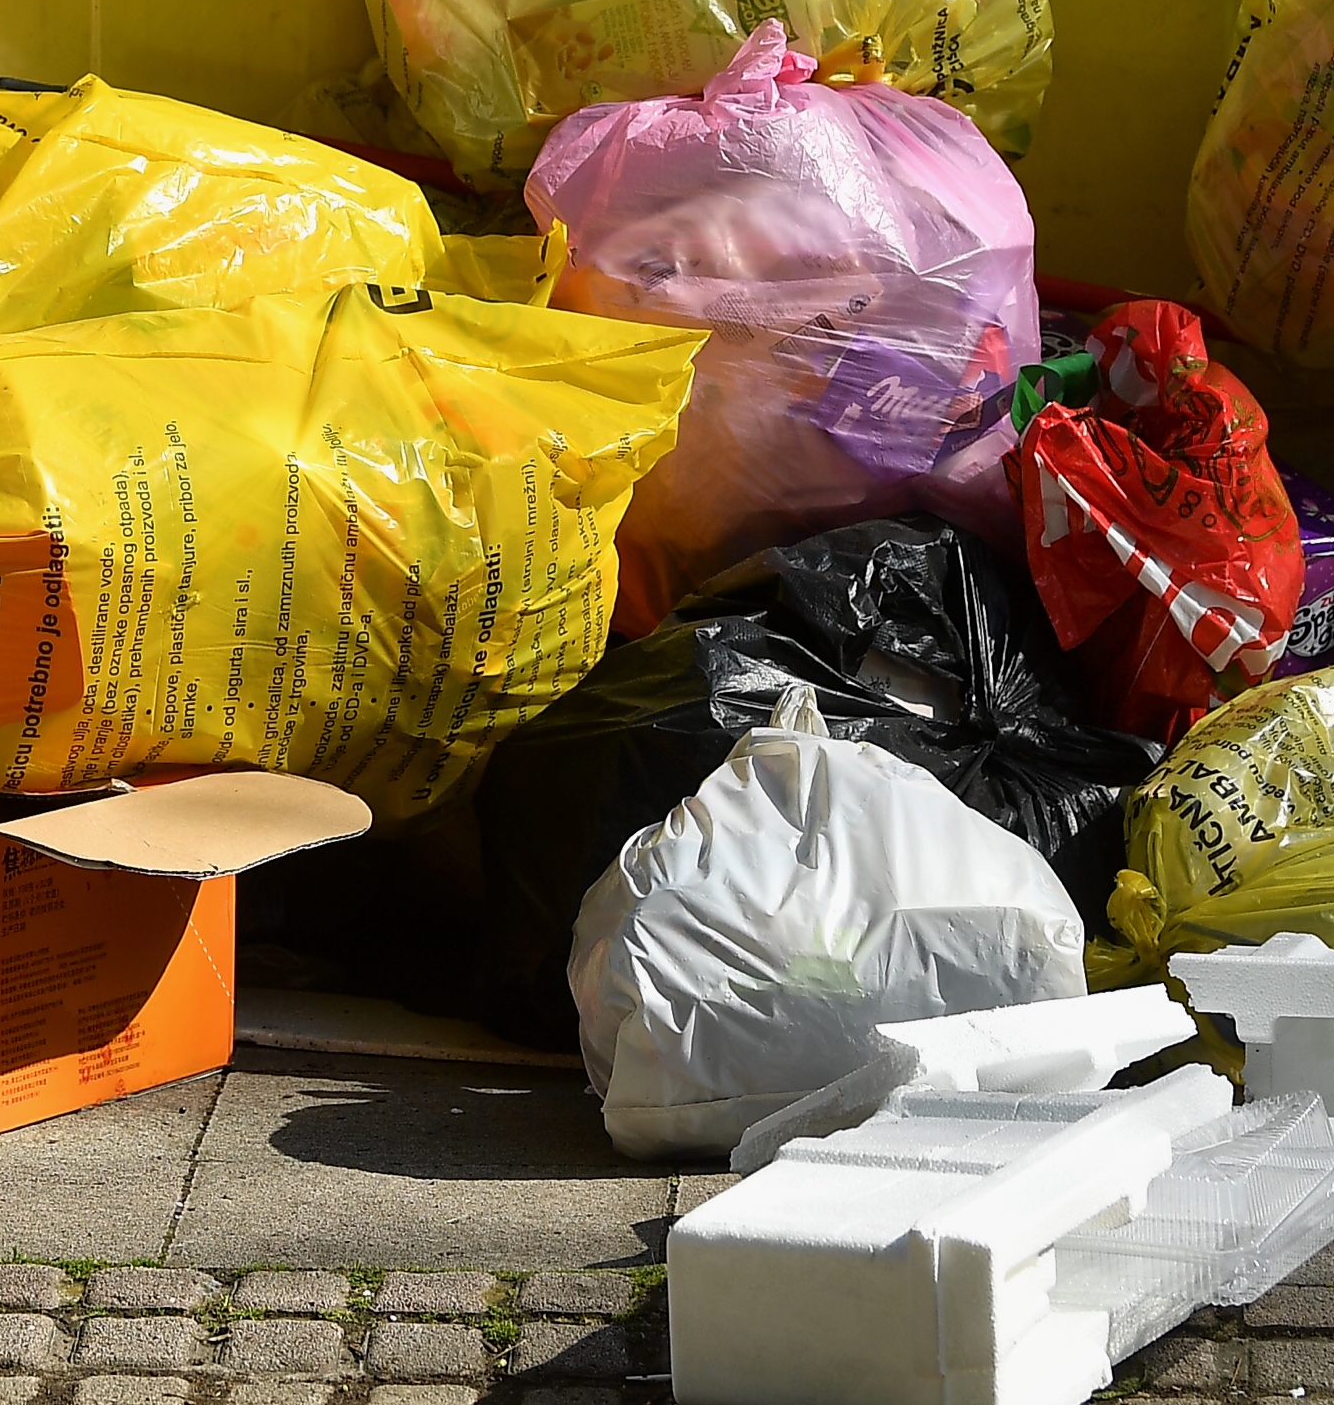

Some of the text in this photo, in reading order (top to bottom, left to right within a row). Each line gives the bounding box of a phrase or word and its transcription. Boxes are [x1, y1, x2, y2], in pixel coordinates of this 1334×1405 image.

[179, 476, 198, 524] pribor
[23, 506, 70, 740] potrebno odlagati:
[89, 541, 116, 677] destilirane vode,
[109, 541, 139, 677] oznake opasnog
[128, 479, 157, 680] prehrambenih proizvoda
[266, 539, 296, 740] grickalica, od zamrznutih
[331, 553, 357, 694] zaštitnu plastičnu
[440, 579, 462, 662] ambalažu.
[446, 542, 504, 750] vrećicu odlagati:
[180, 677, 201, 739] slamke,
[227, 608, 248, 705] jogurta, sira
[290, 629, 310, 701] trgovina,
[395, 620, 414, 679] limenke
